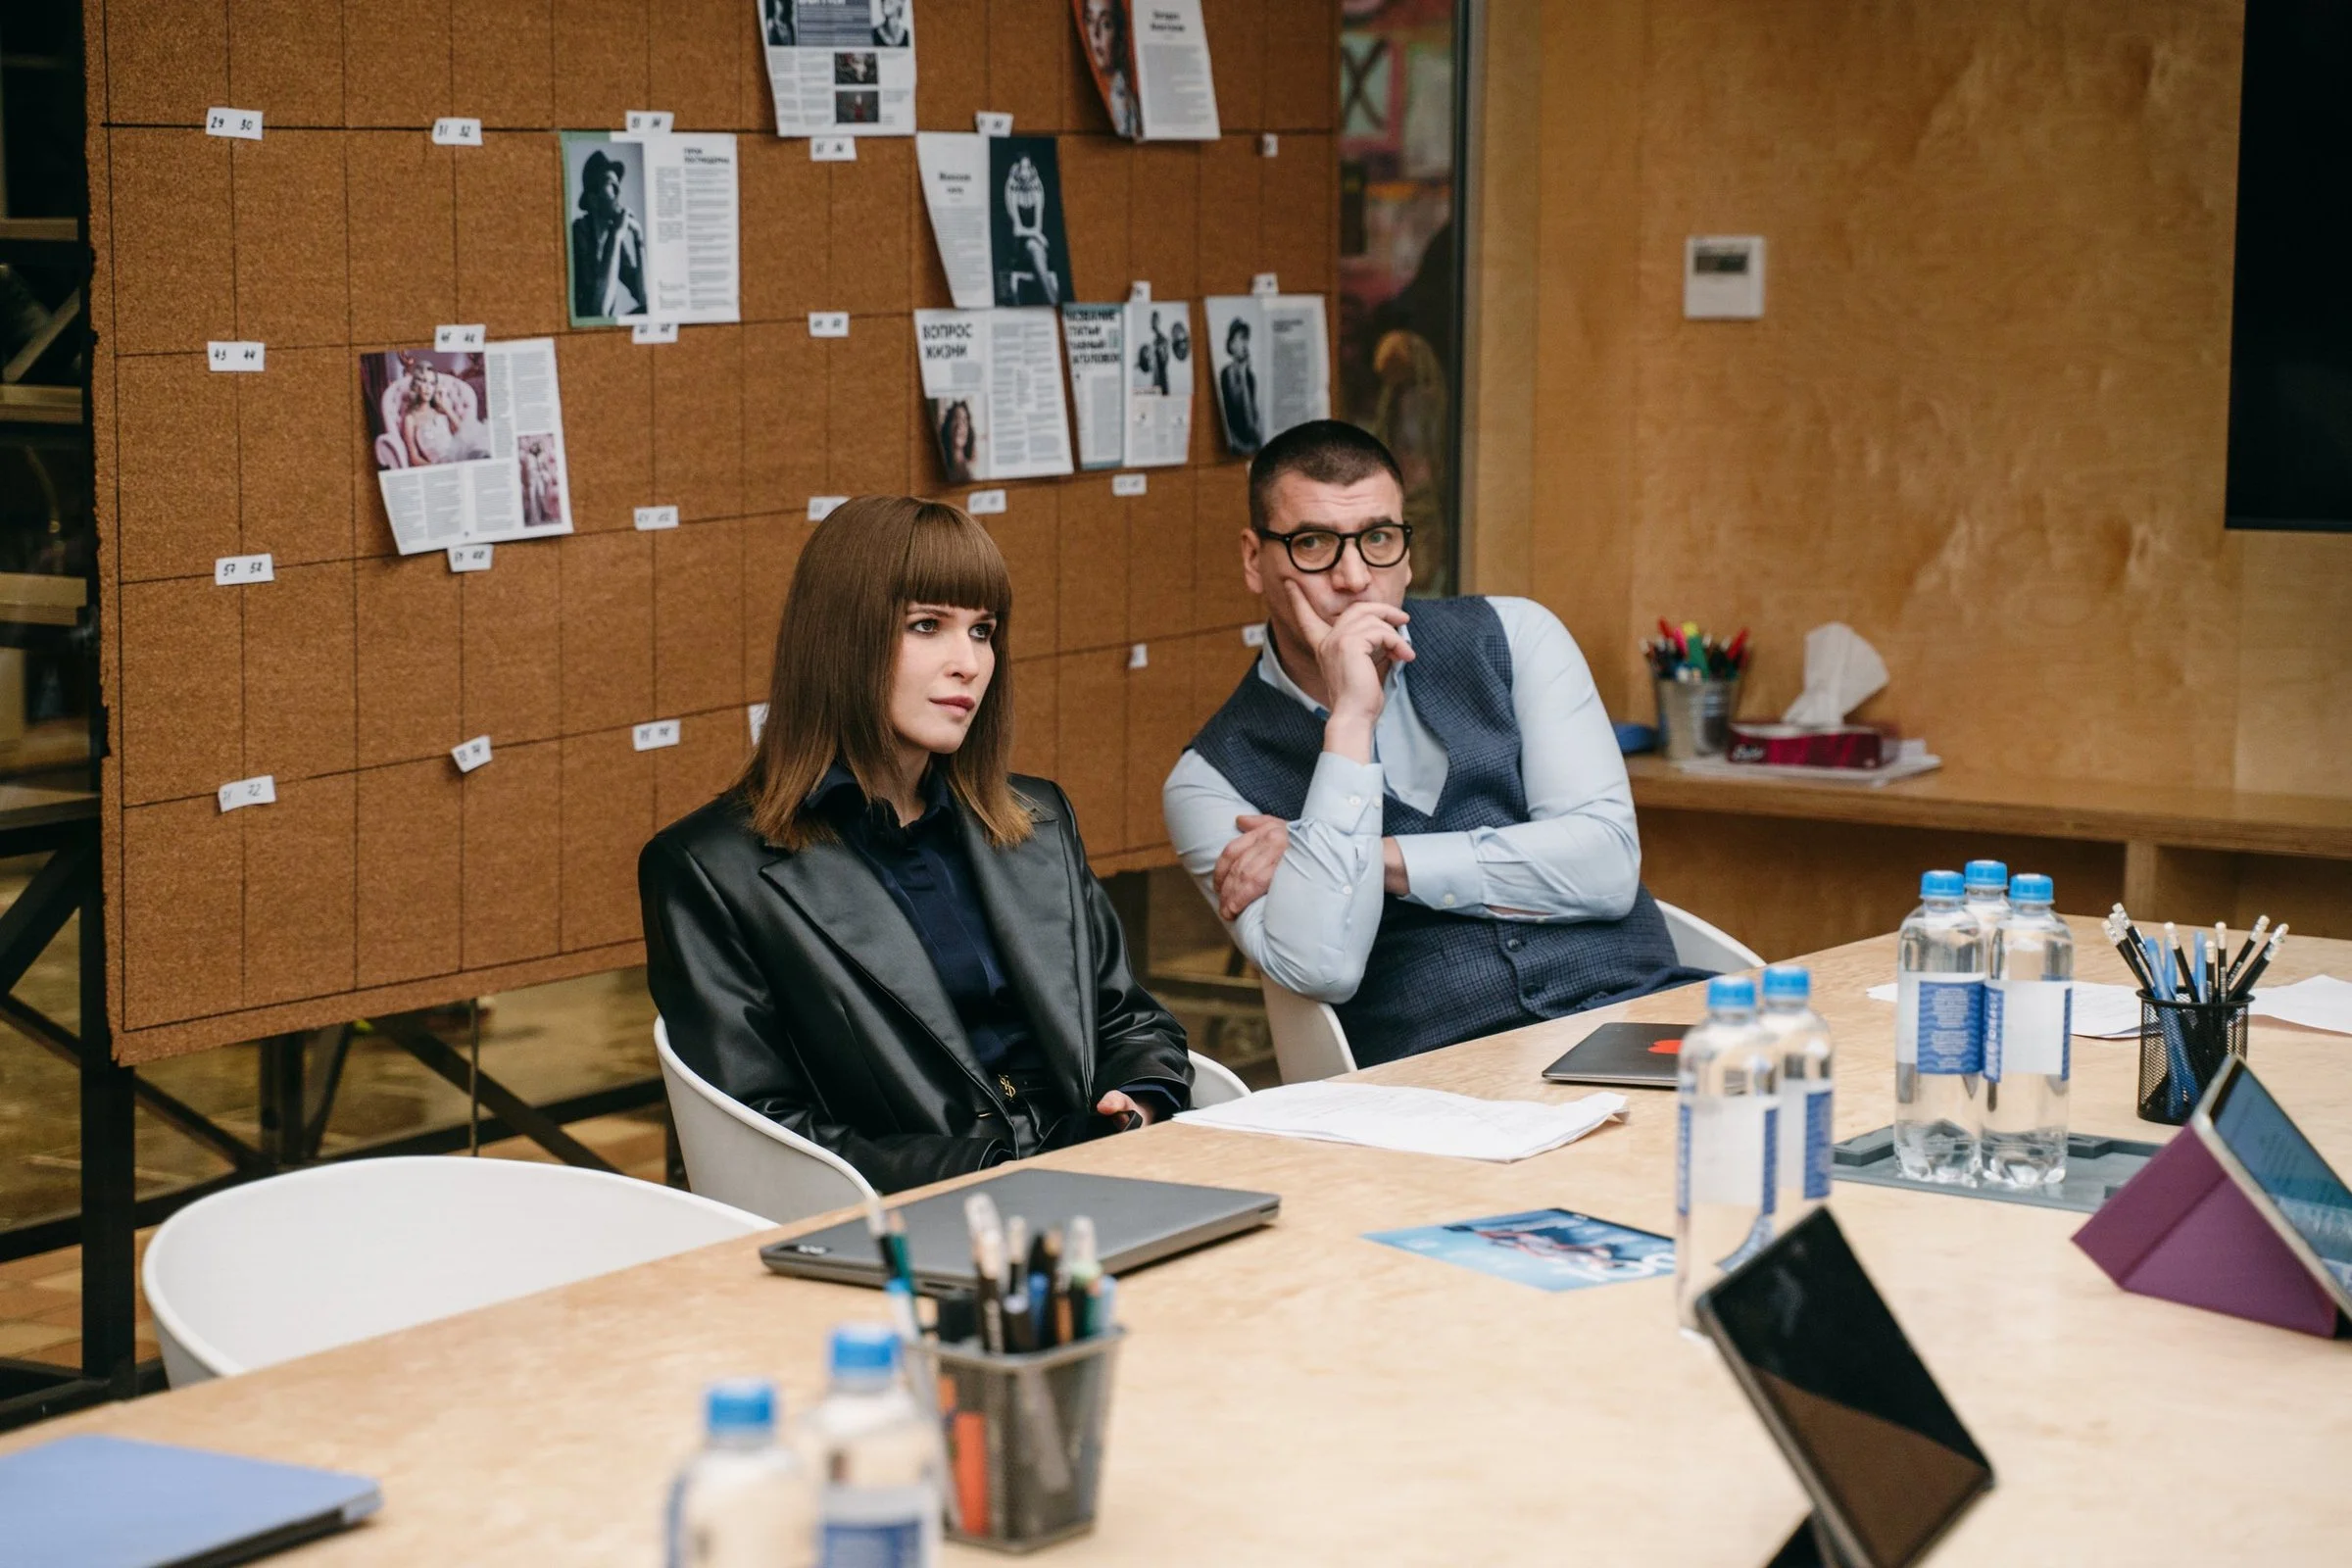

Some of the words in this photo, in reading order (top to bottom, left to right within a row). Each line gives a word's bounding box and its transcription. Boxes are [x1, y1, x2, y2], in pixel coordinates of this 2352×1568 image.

[210, 116, 225, 129] 29
[922, 323, 973, 341] ВОПРОС
[925, 343, 967, 360] ЖИЗНИ
